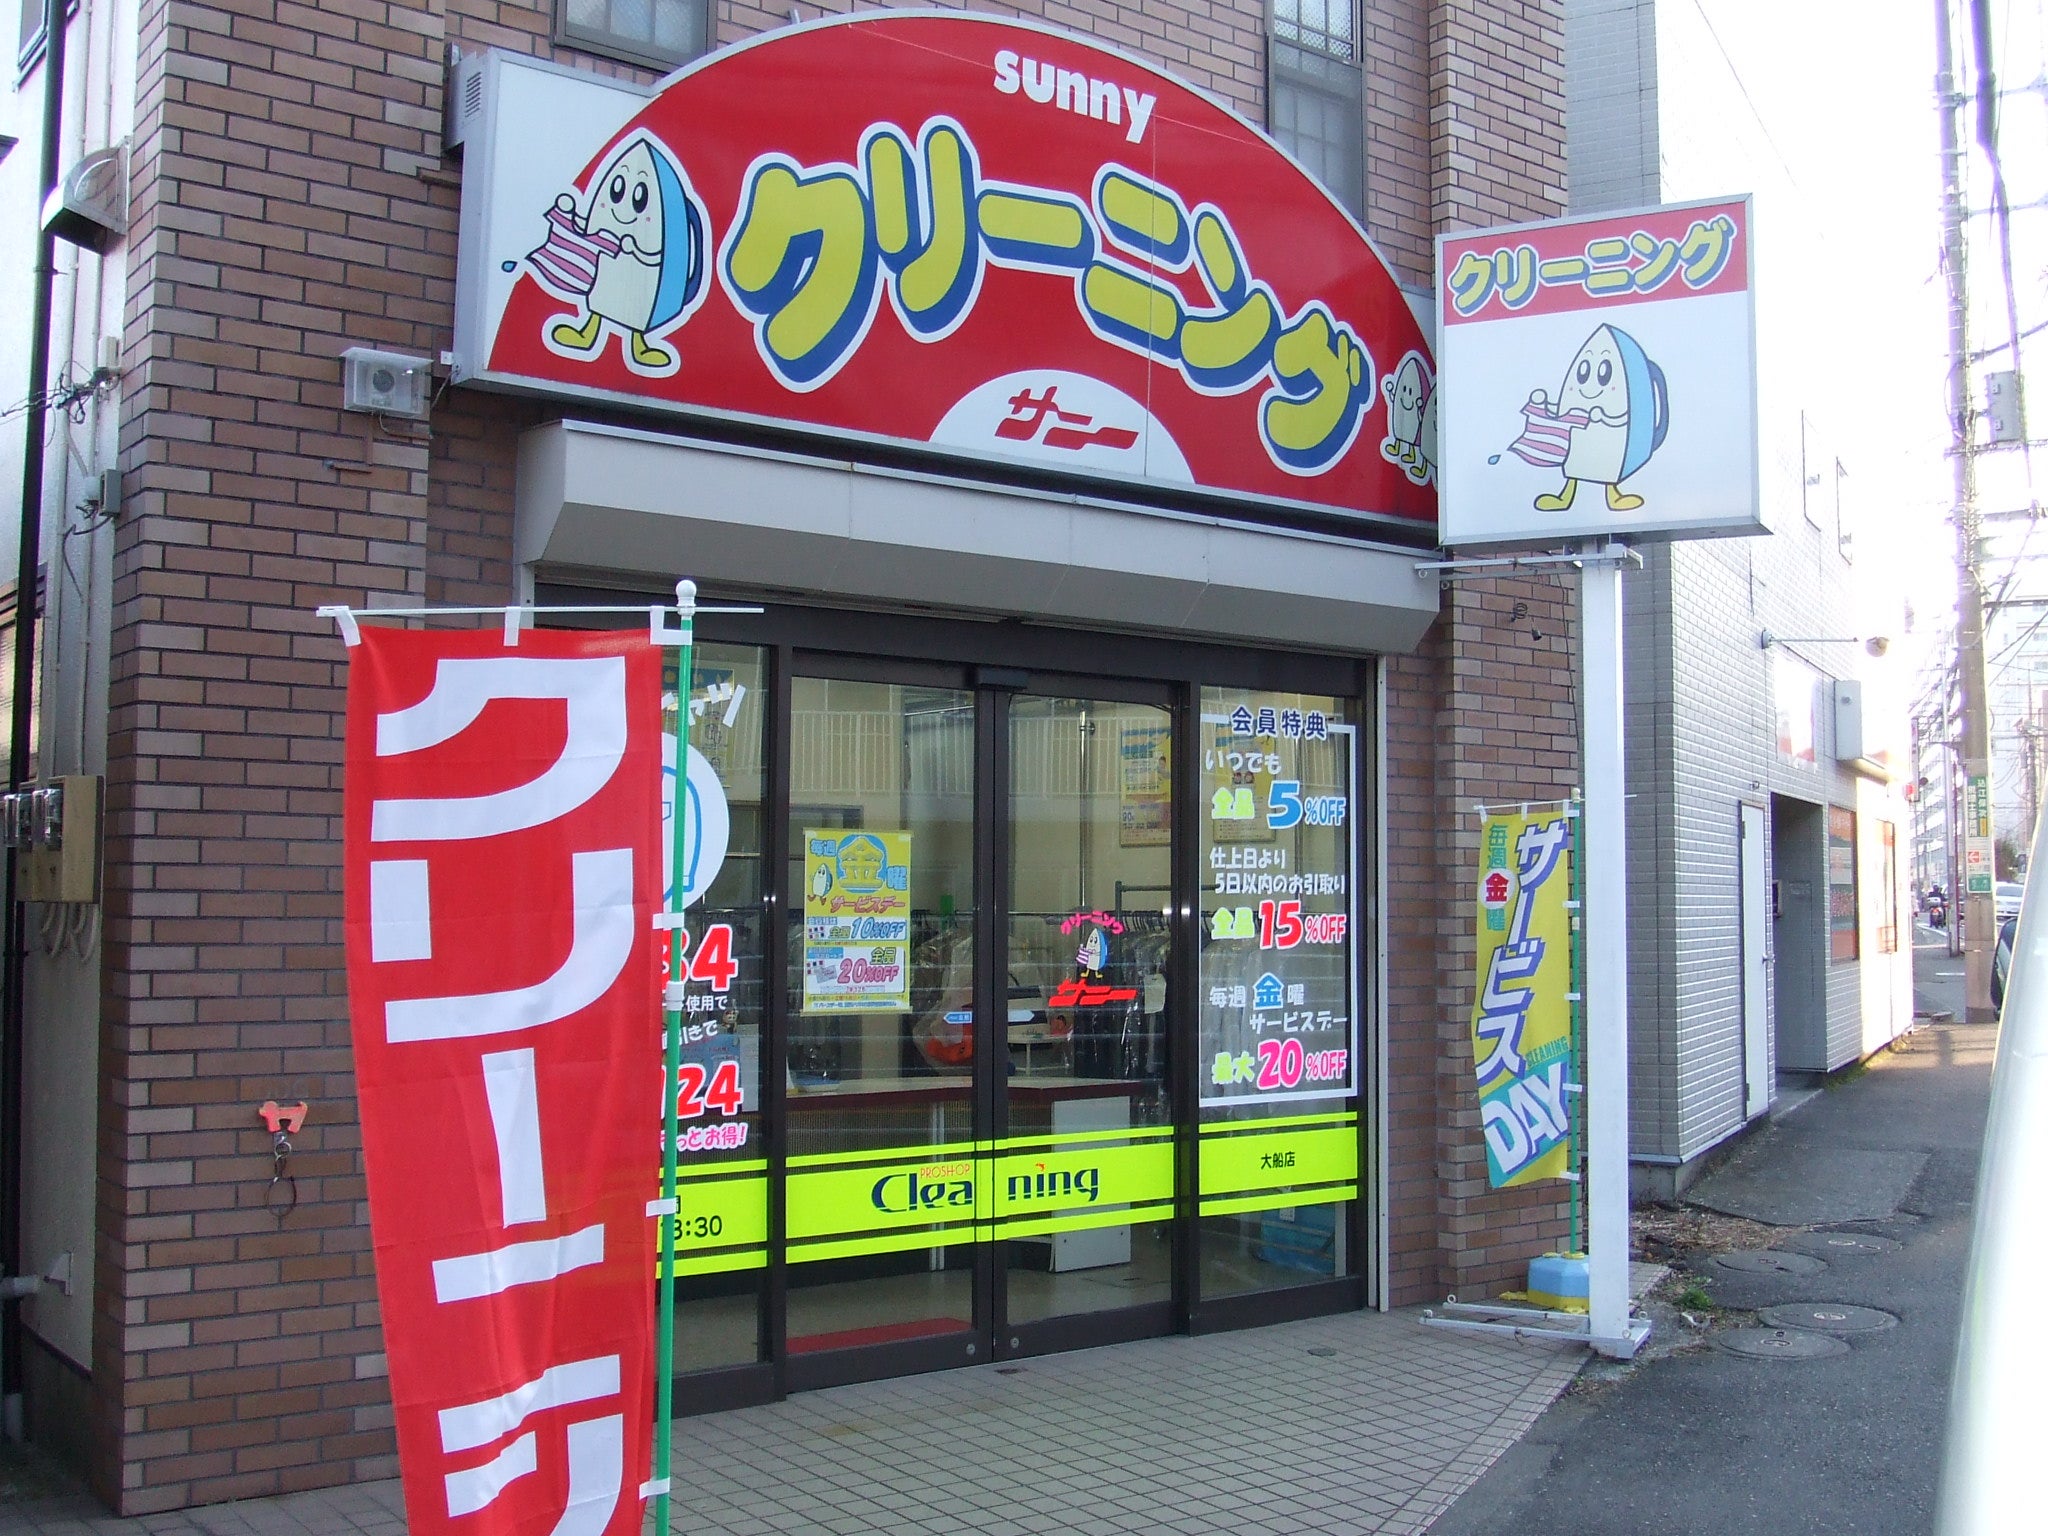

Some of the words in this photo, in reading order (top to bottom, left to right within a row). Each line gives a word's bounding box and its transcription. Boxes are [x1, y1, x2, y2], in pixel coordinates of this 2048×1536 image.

[994, 50, 1157, 144] sunny
[1450, 214, 1736, 317] クリーニング
[718, 117, 1373, 474] クリーニング
[995, 386, 1138, 450] サニー
[1231, 705, 1327, 740] 会員特典
[1205, 749, 1281, 775] いつでも
[1209, 847, 1286, 870] 仕上日より
[1215, 872, 1346, 895] 5日以内のお引取り
[830, 895, 906, 914] サービスデー
[1475, 819, 1568, 1087] サービス
[1049, 978, 1138, 1007] サニー
[1250, 1010, 1347, 1035] サービスデー
[1525, 1035, 1569, 1068] CLEANING
[1481, 1062, 1569, 1174] DAY
[920, 1163, 971, 1179] PROSHOP
[1261, 1151, 1296, 1170] 大船店
